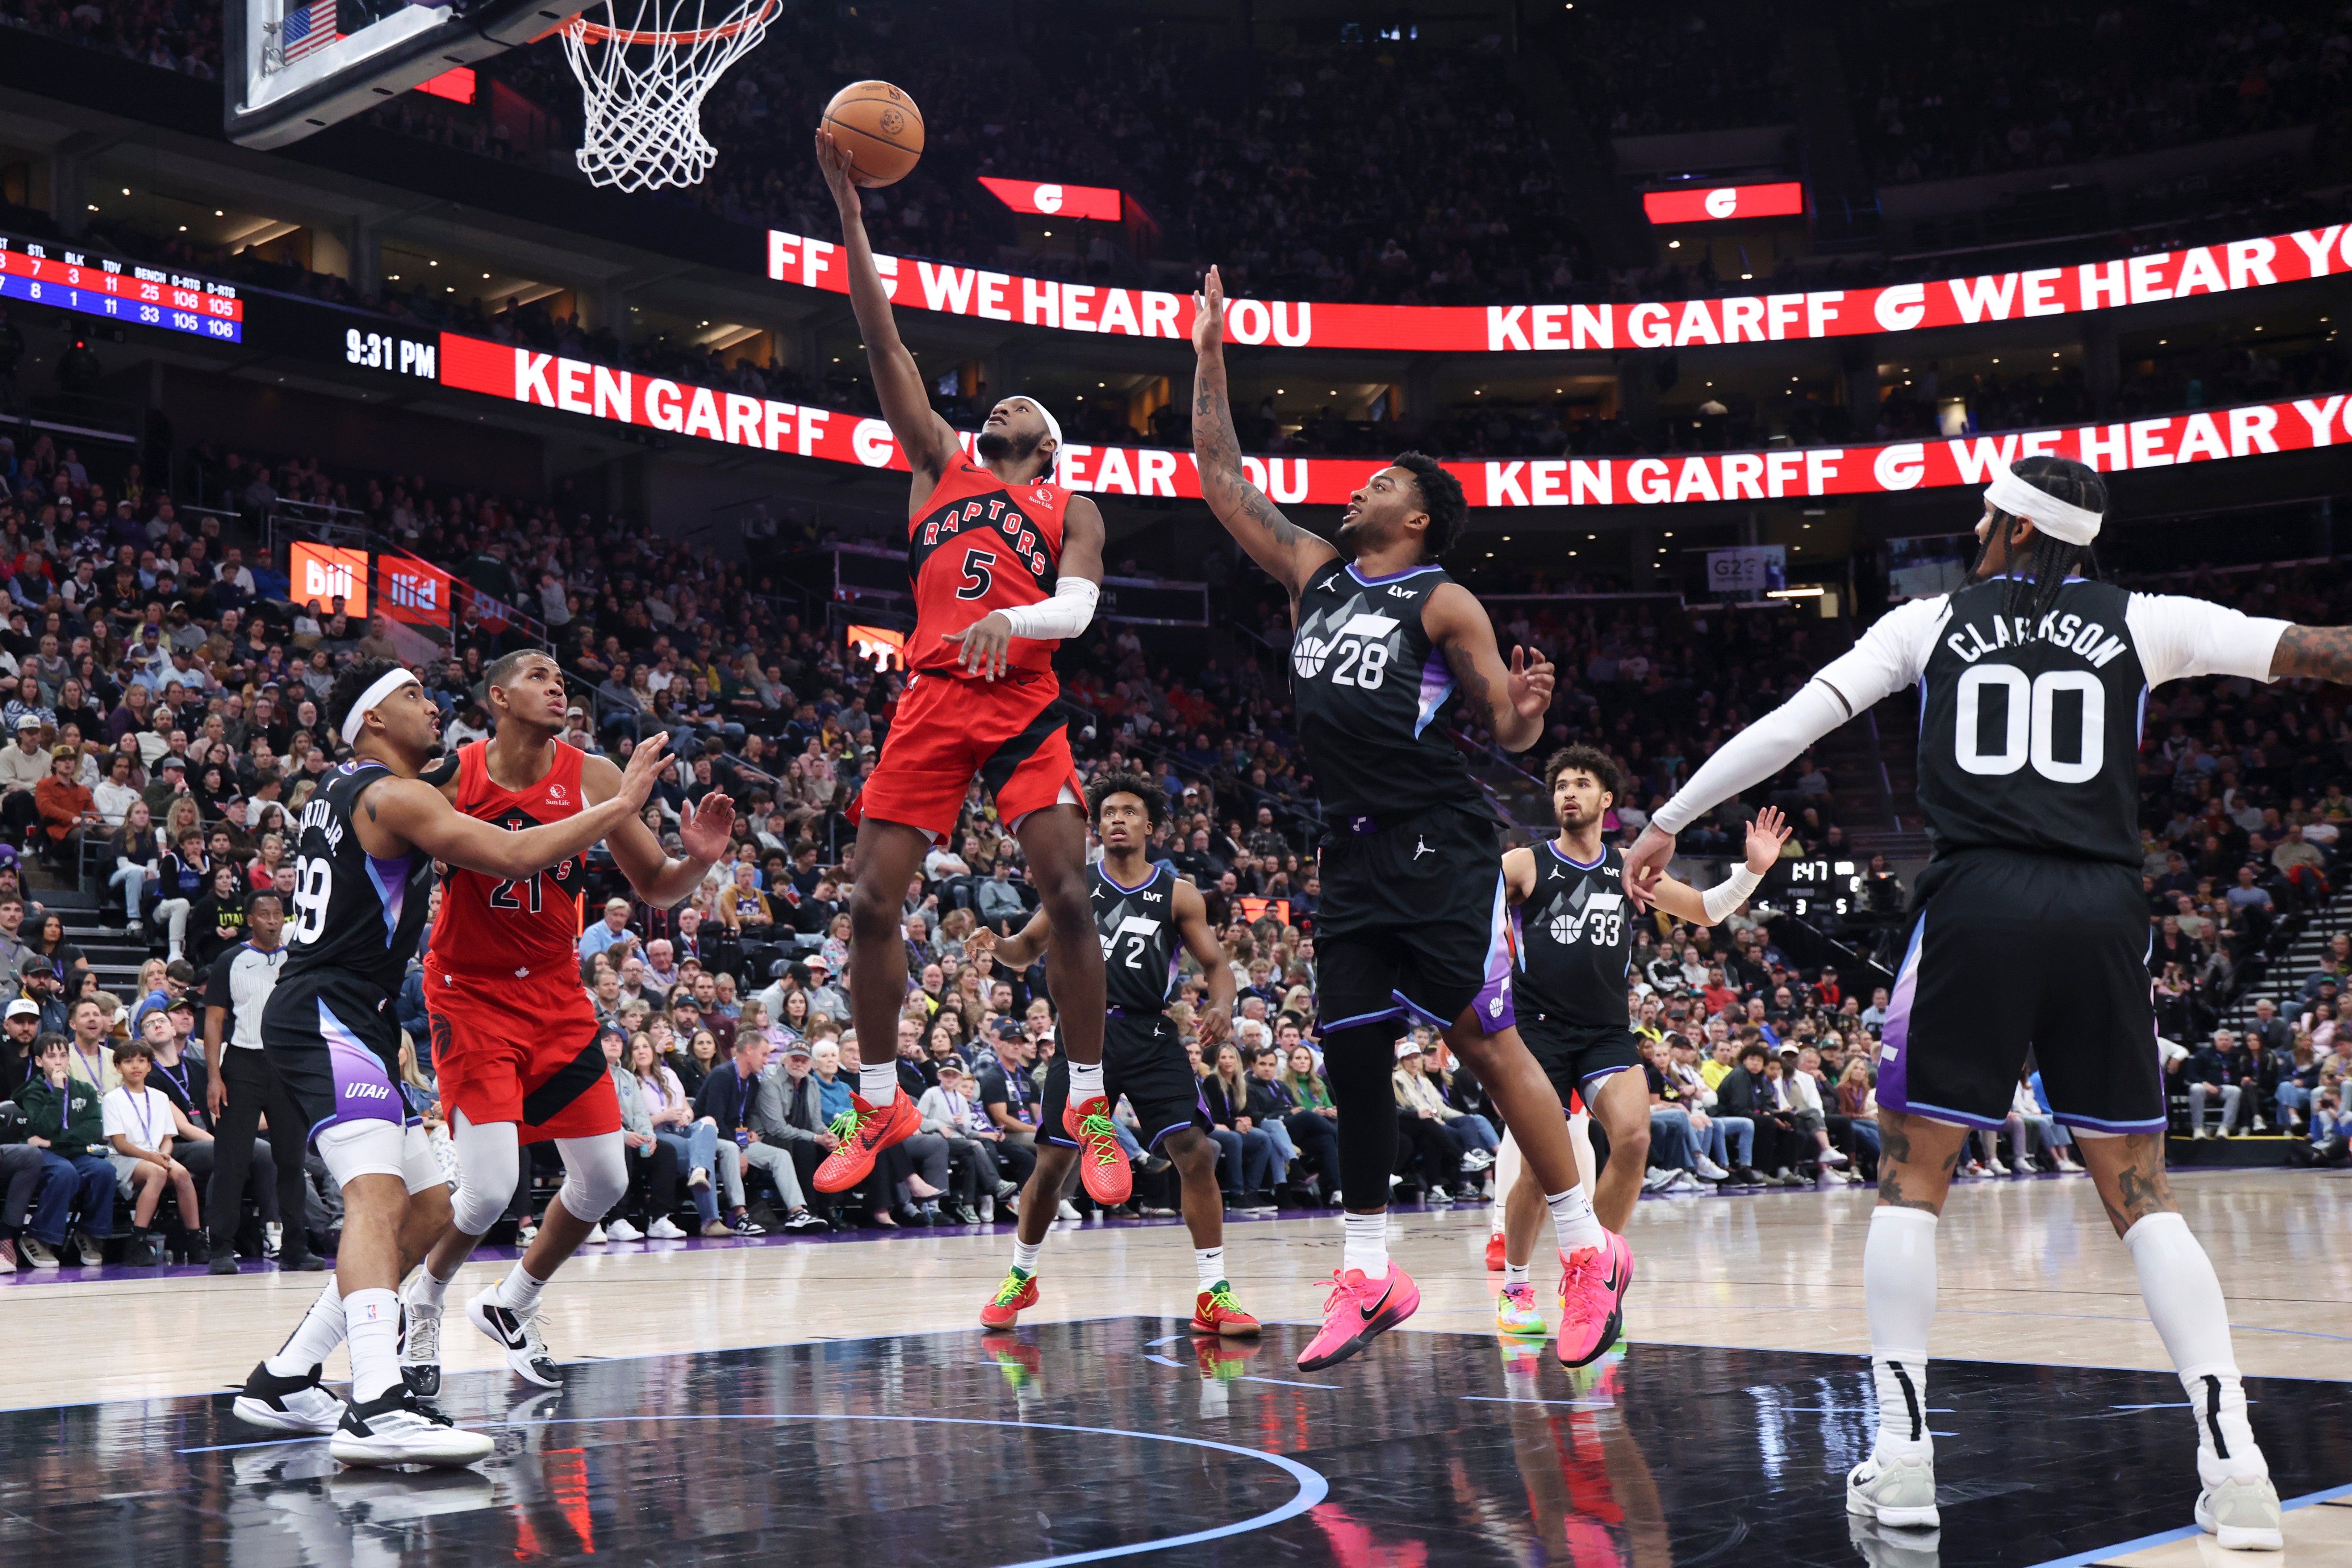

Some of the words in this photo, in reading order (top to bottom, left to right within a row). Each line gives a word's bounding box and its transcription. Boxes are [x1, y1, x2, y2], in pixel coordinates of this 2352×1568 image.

[27, 244, 46, 259] STL
[64, 251, 84, 266] BLK
[102, 260, 121, 274] TOV
[134, 267, 166, 284] BENCH
[30, 282, 41, 298] 8
[70, 292, 77, 307] 1
[104, 298, 117, 314] 11
[140, 305, 159, 323] 33
[172, 312, 199, 331] 105
[207, 320, 233, 338] 106
[31, 260, 41, 275] 7
[68, 268, 79, 284] 3
[105, 276, 117, 292] 11
[141, 284, 159, 301] 25
[173, 291, 199, 309] 106
[208, 298, 233, 316] 105
[918, 262, 1011, 321] WE
[1023, 277, 1181, 339] HEAR
[1487, 304, 1614, 351] KEN
[1628, 291, 1844, 348] GARFF
[1949, 268, 2065, 323] WE
[2079, 238, 2278, 311] HEAR
[346, 328, 392, 370] 9:31
[400, 339, 435, 379] PM
[515, 347, 632, 423] KEN
[644, 378, 829, 456] GARFF
[1056, 444, 1177, 496] EAR
[1486, 459, 1612, 506] KEN
[1626, 449, 1843, 504] GARFF
[2079, 405, 2280, 472] HEAR
[1028, 495, 1041, 505] Sun
[1042, 500, 1053, 510] Life
[924, 499, 1046, 576] RAPTORS
[306, 559, 352, 599] bill
[956, 548, 997, 600] 5
[1387, 585, 1419, 599] LVT
[1331, 639, 1389, 690] 28
[1955, 664, 2105, 783] 00
[325, 815, 343, 857] JR.
[490, 870, 542, 913] 21
[1602, 866, 1620, 878] LVT
[1792, 861, 1827, 881] 1:47
[293, 855, 332, 944] 99
[1143, 890, 1163, 903] LVT
[1796, 899, 1806, 915] 3
[1835, 898, 1847, 915] 5
[1125, 936, 1146, 969] 2
[1590, 913, 1621, 946] 33
[345, 1082, 391, 1100] UTAH
